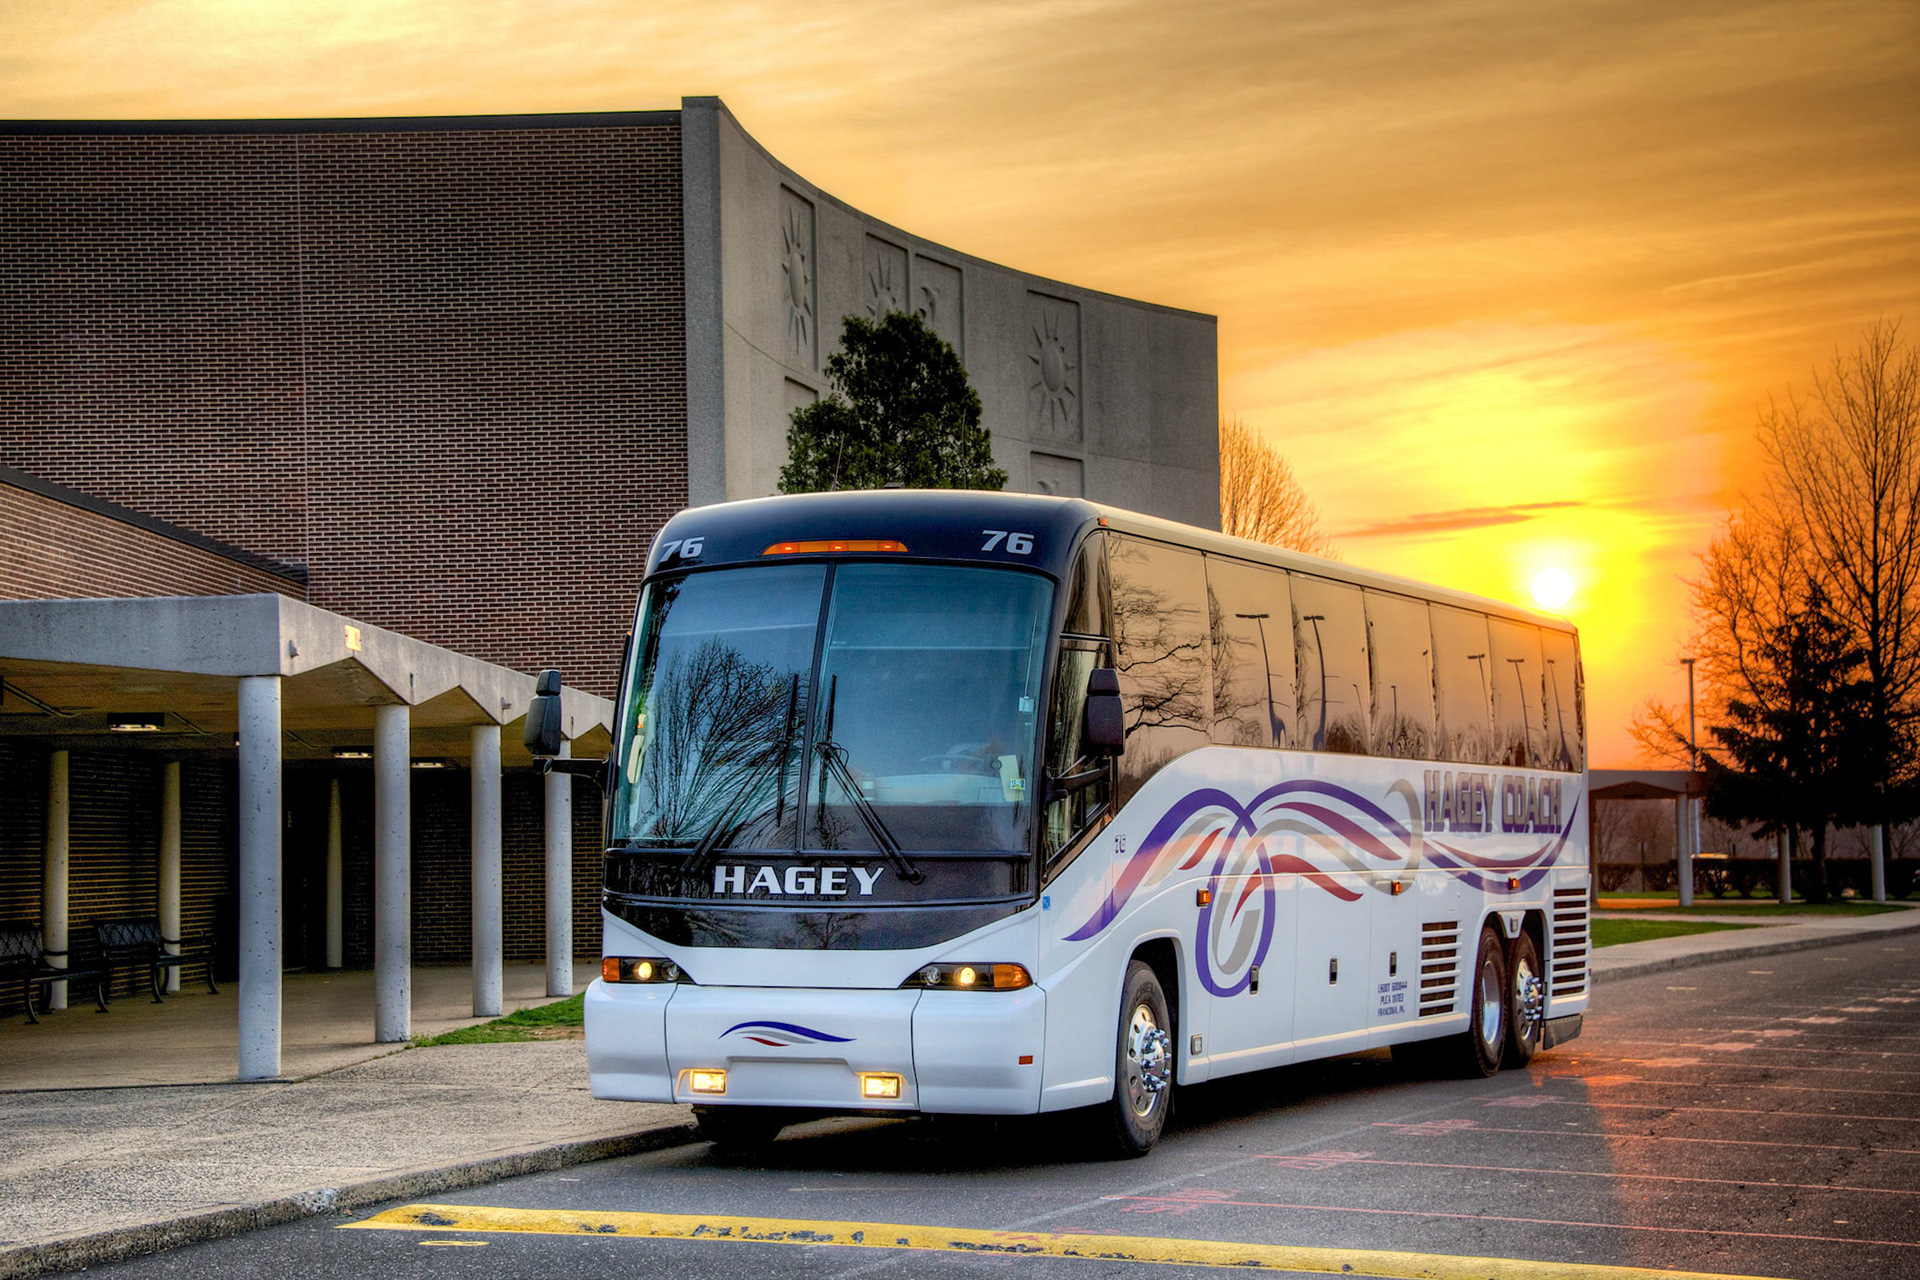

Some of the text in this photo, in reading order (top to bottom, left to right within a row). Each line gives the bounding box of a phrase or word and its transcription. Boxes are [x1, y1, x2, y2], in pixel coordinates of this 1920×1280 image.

[660, 536, 705, 563] 76
[981, 529, 1035, 555] 76
[1423, 769, 1562, 834] HAGEY COACH
[713, 865, 885, 896] HAGEY
